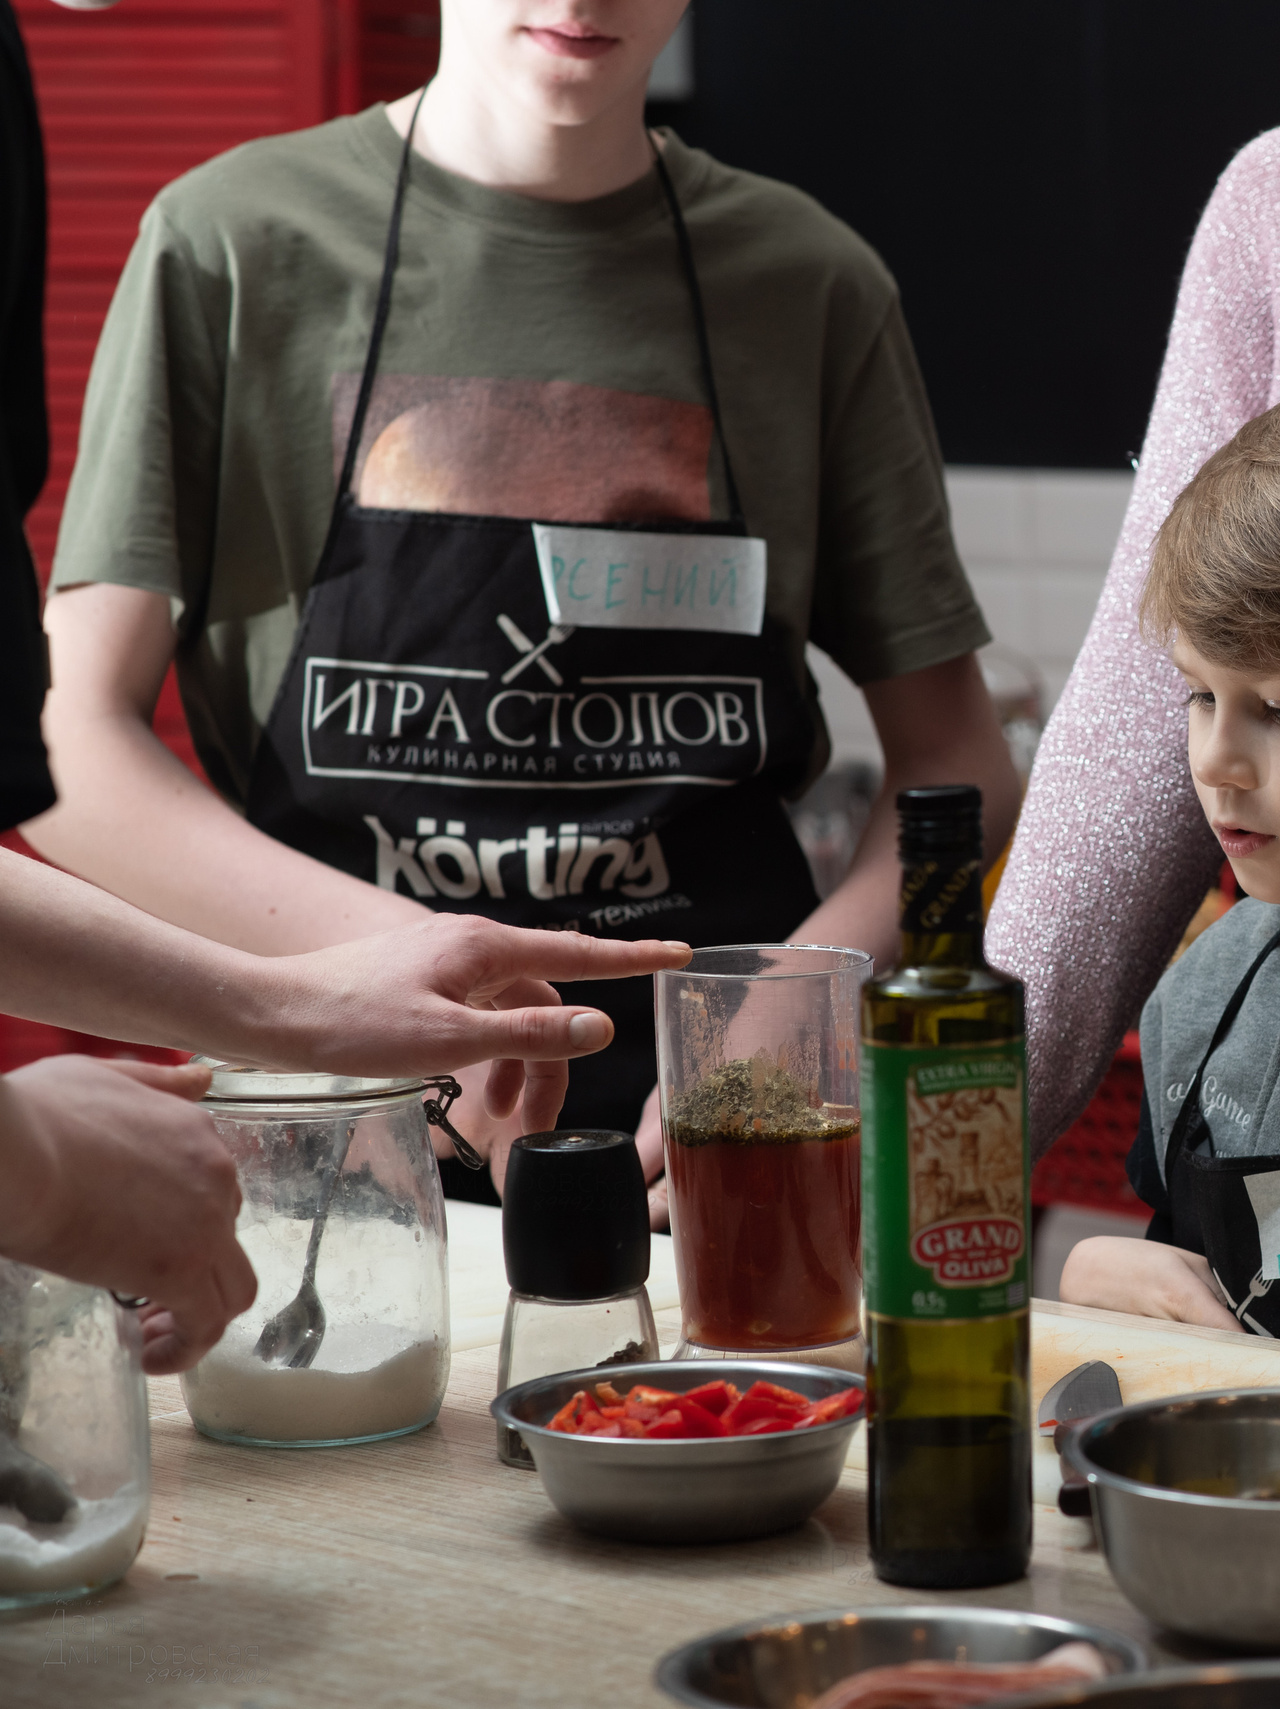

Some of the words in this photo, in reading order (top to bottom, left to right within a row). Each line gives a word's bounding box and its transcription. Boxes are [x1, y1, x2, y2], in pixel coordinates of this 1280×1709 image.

[551, 554, 739, 611] РСЕНИЙ
[312, 674, 471, 744] ИГРА
[485, 688, 751, 749] СТОЛОВ
[366, 744, 558, 774] КУЛИНАРНАЯ
[573, 750, 682, 774] СТУДИЯ
[362, 814, 671, 901] körting
[920, 1223, 1020, 1258] GRAND
[942, 1256, 1007, 1279] OLIVA
